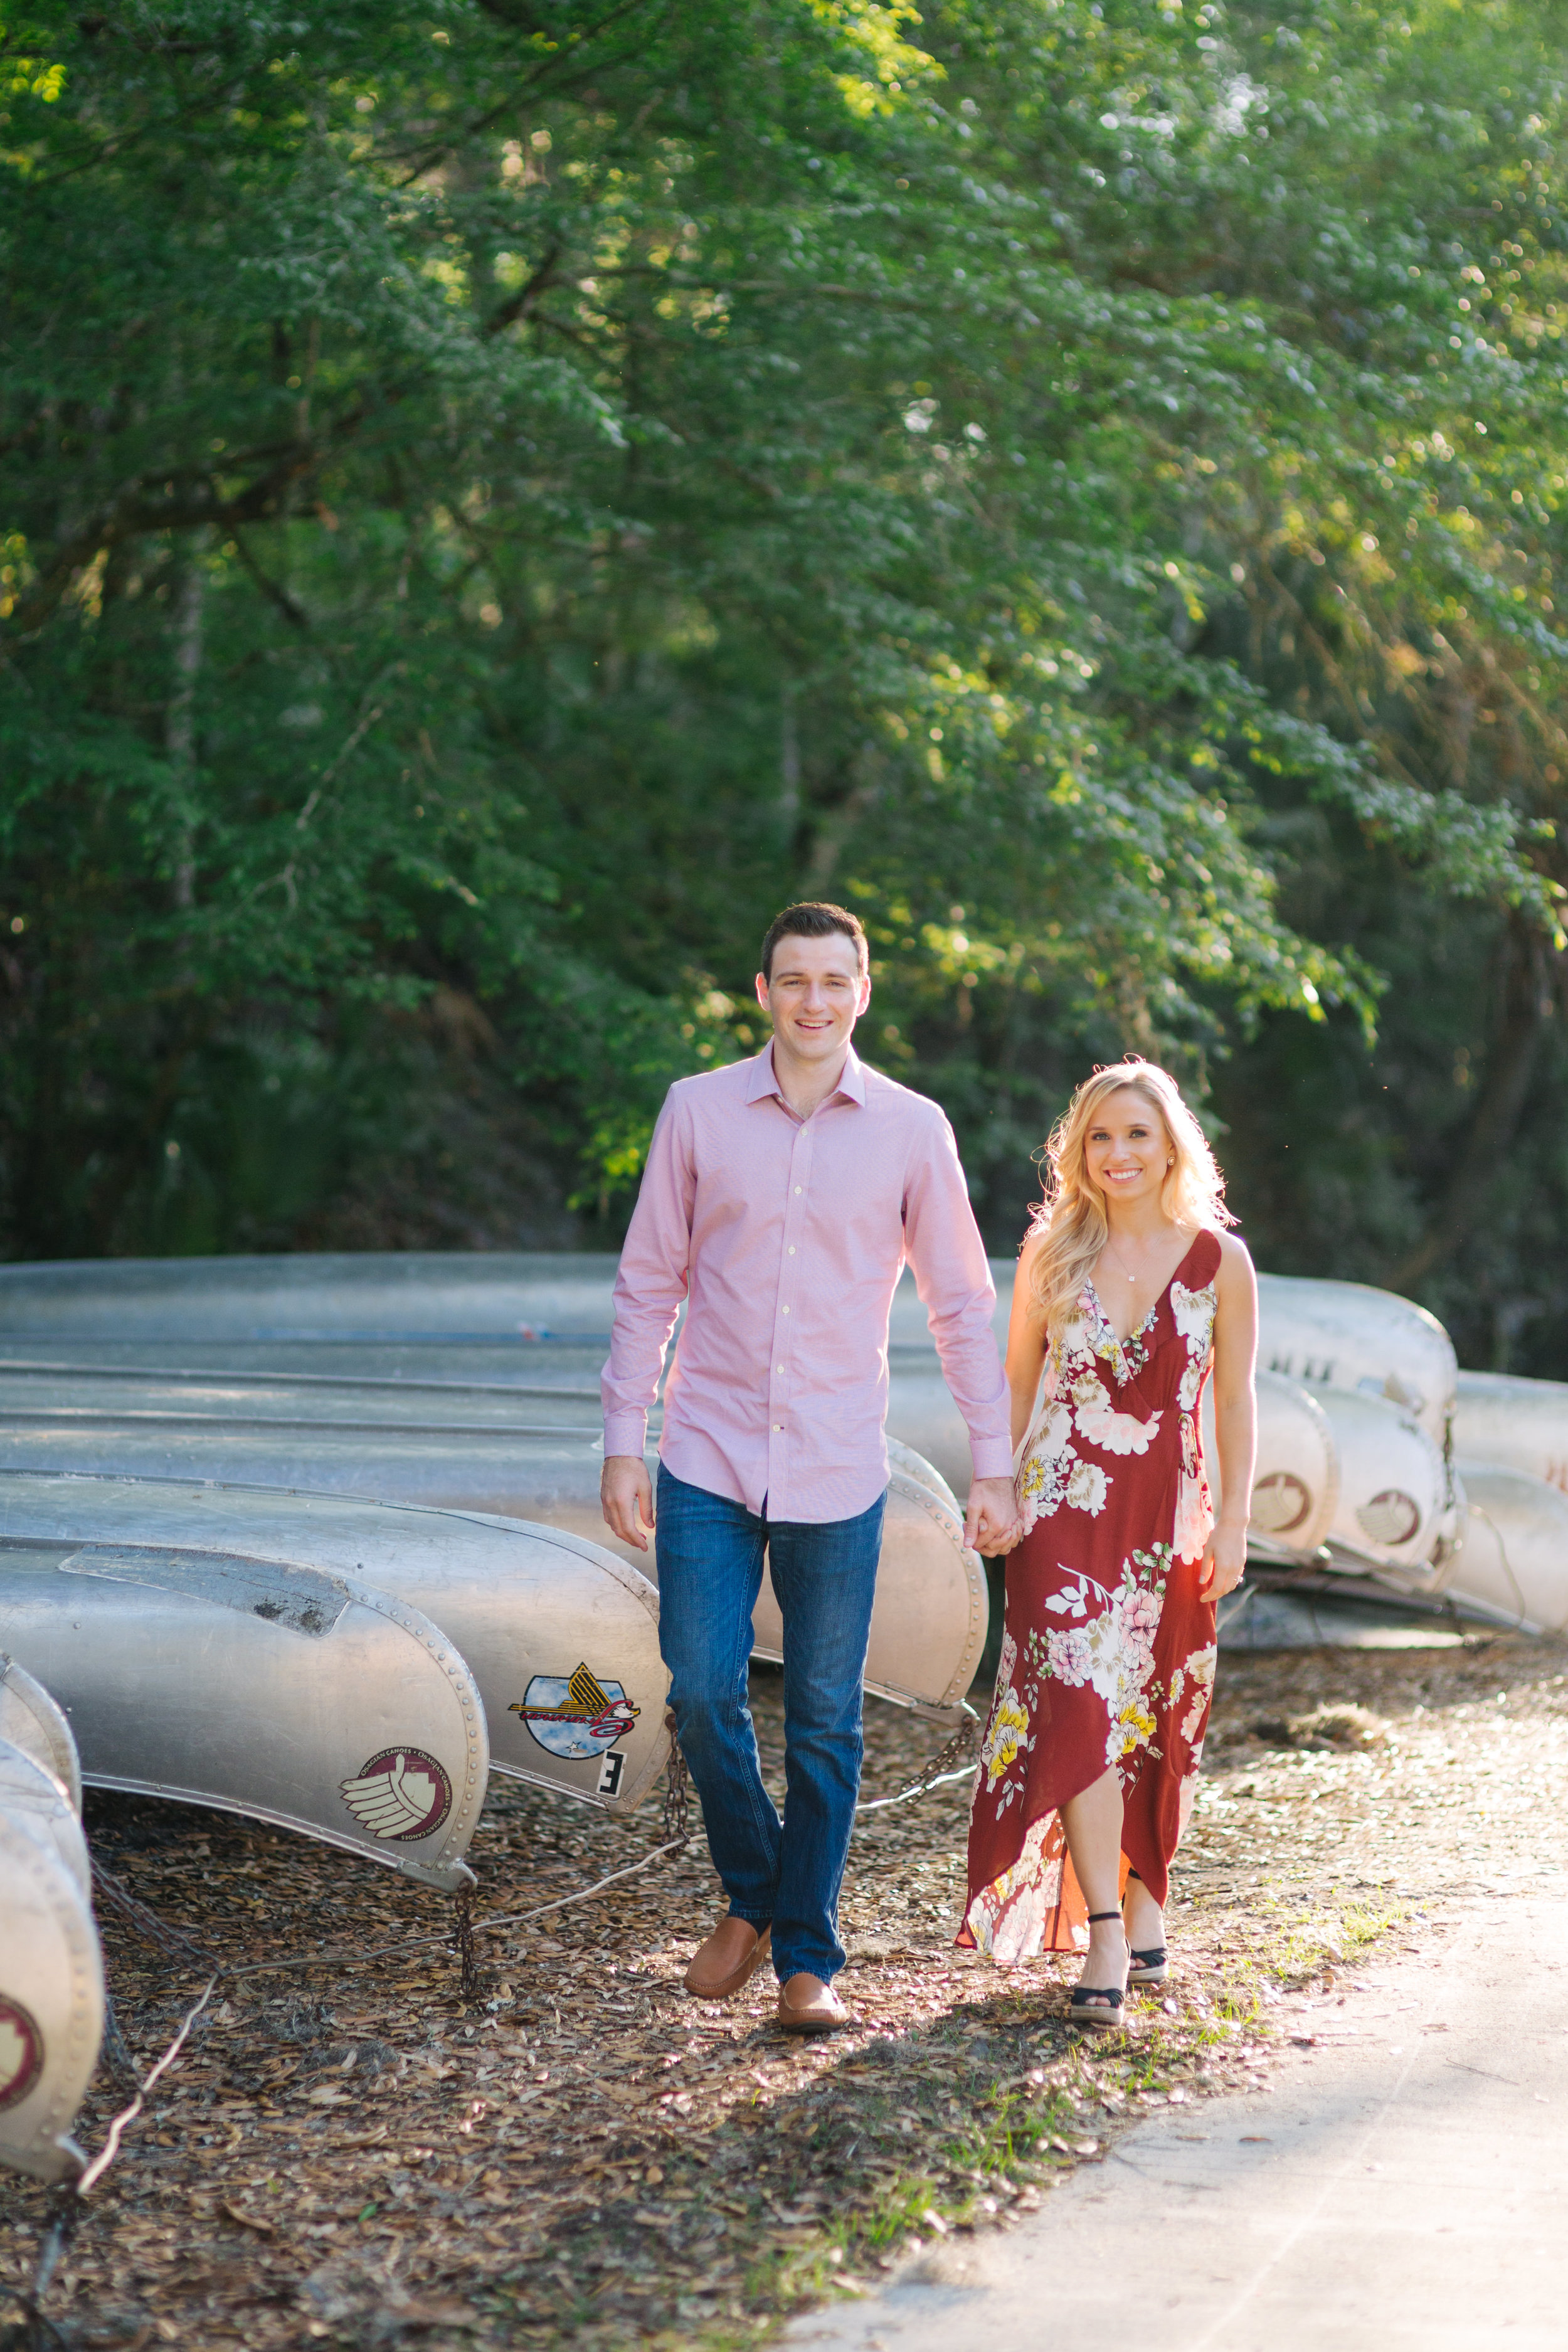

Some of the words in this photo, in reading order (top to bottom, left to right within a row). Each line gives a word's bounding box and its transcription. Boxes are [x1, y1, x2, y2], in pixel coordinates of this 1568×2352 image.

[361, 1752, 386, 1776] OSAGIAN
[418, 1751, 444, 1776] OSAGIAN
[442, 1776, 450, 1801] CANOES
[426, 1808, 448, 1834] OSAGIAN
[401, 1831, 426, 1840] CANOES
